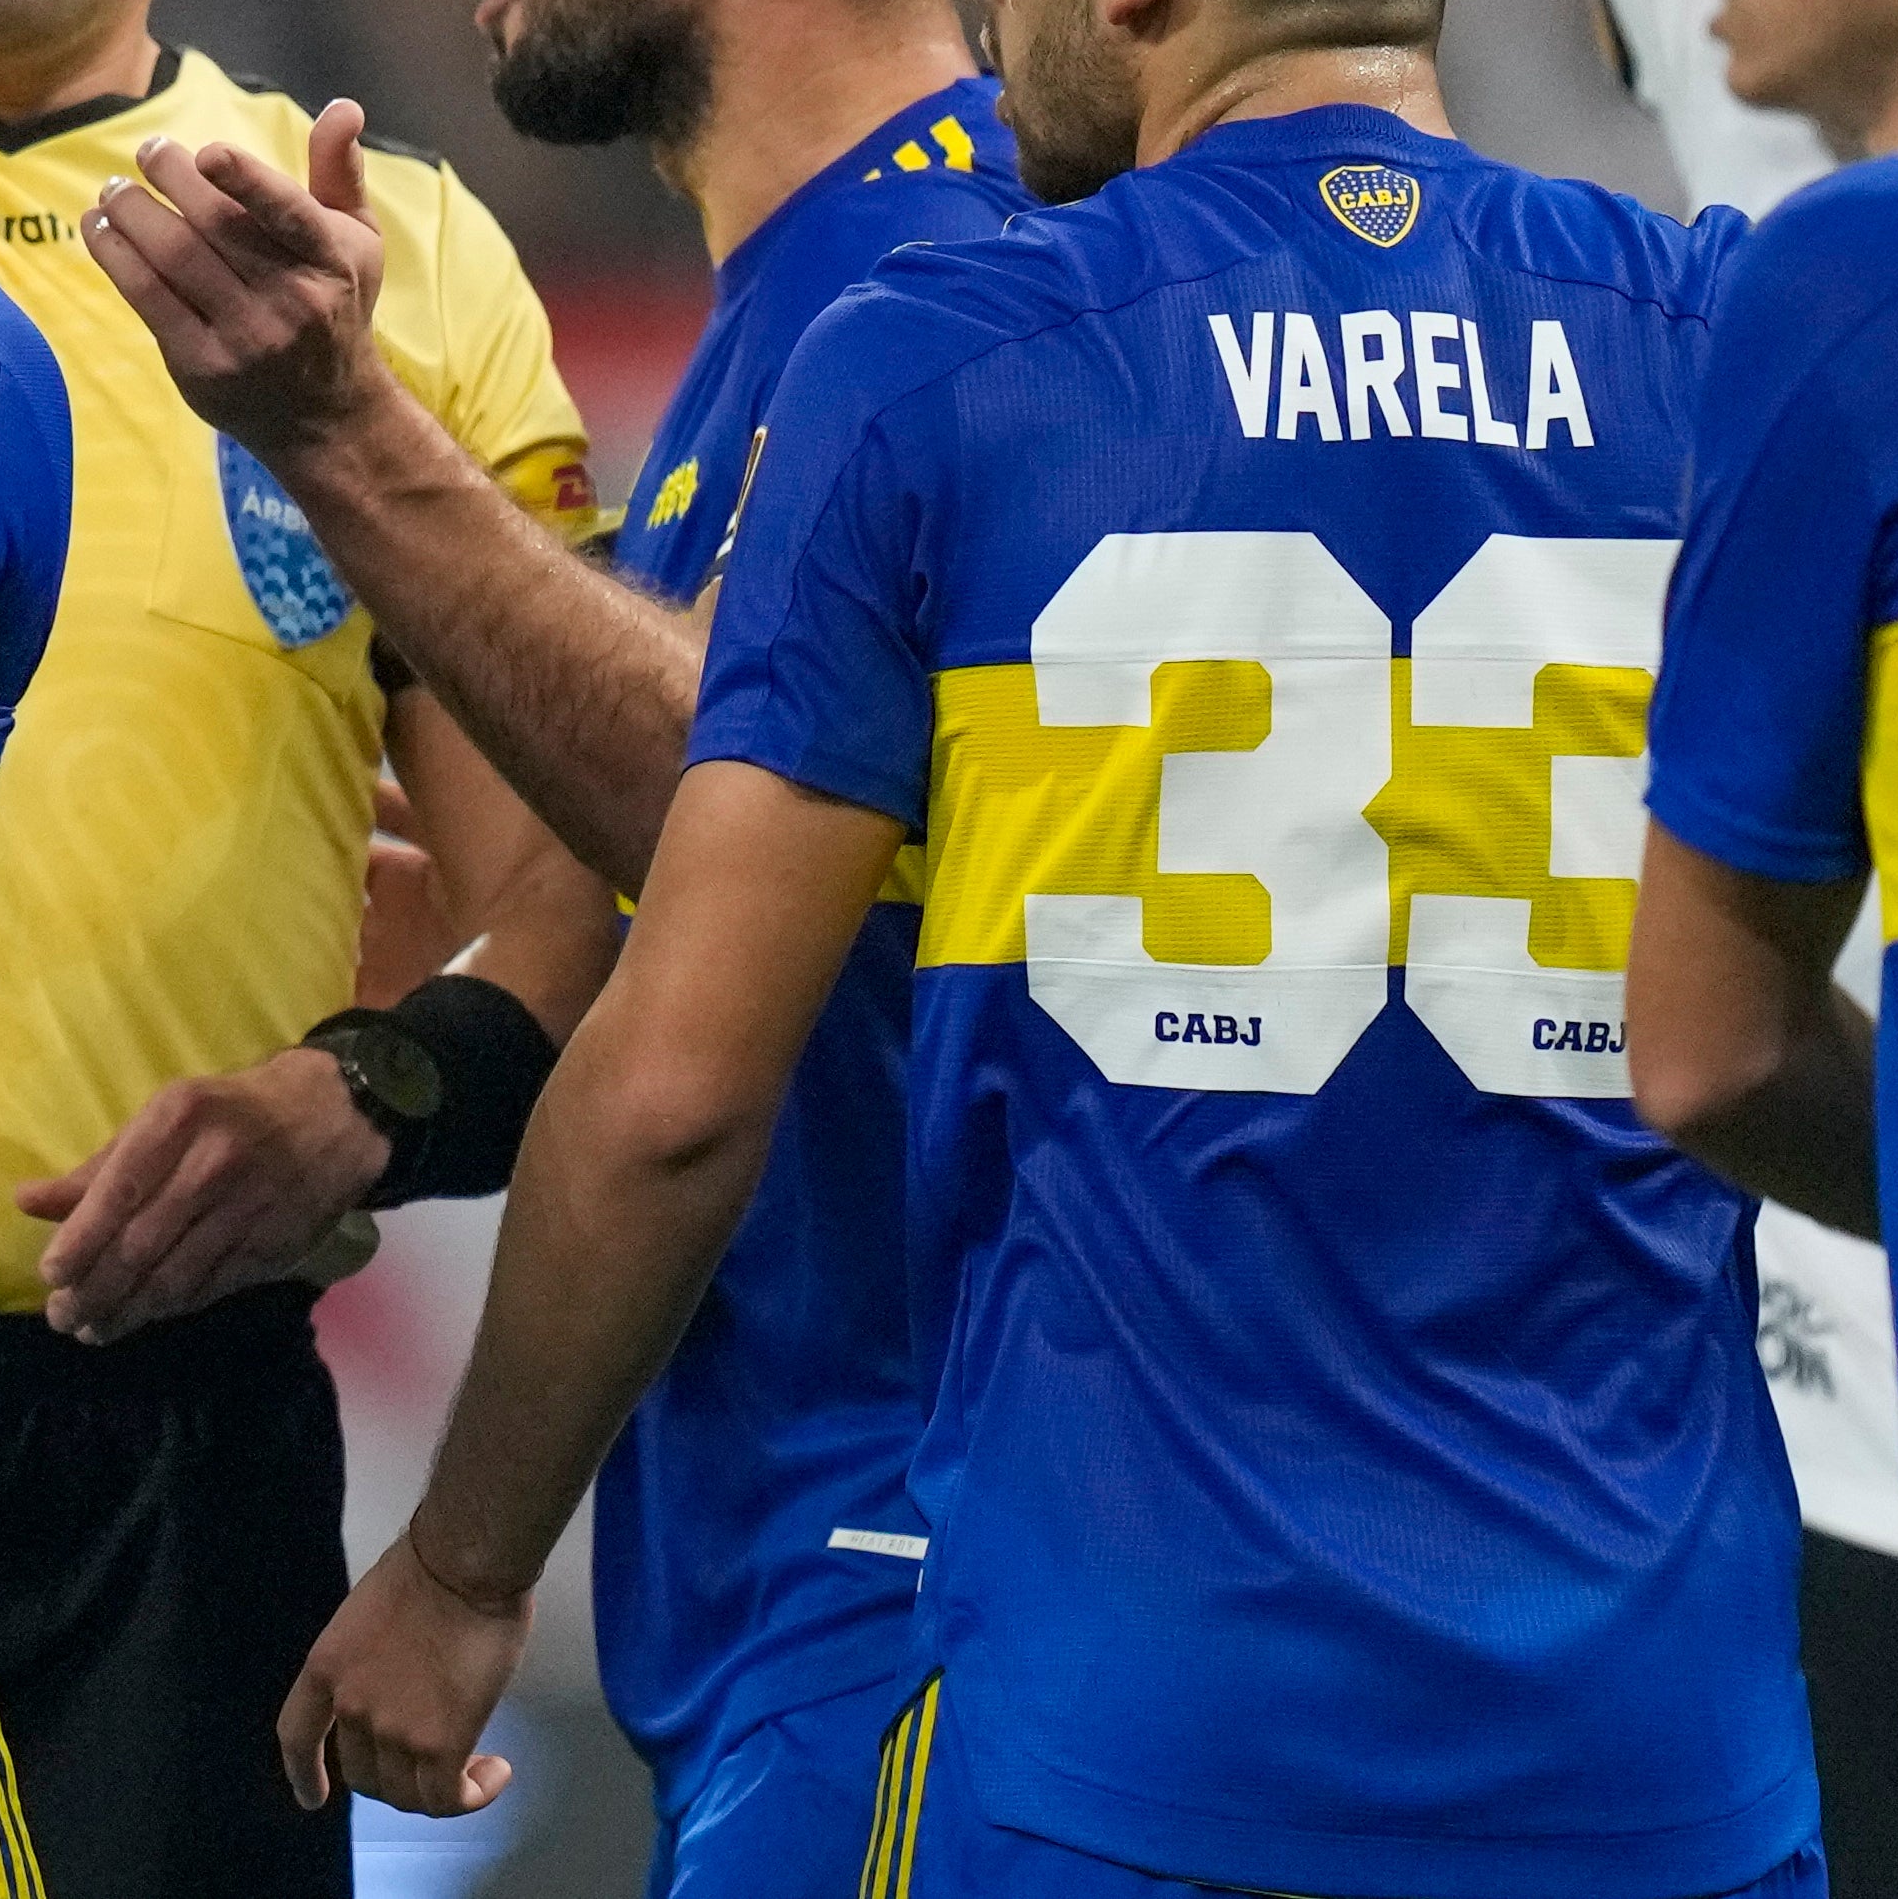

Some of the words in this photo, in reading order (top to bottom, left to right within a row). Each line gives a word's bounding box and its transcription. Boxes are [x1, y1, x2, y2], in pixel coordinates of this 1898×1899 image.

[1339, 189, 1408, 209] CABJ
[1208, 309, 1595, 450] VARELA
[1025, 531, 1683, 1099] 33
[1154, 1011, 1262, 1046] CABJ
